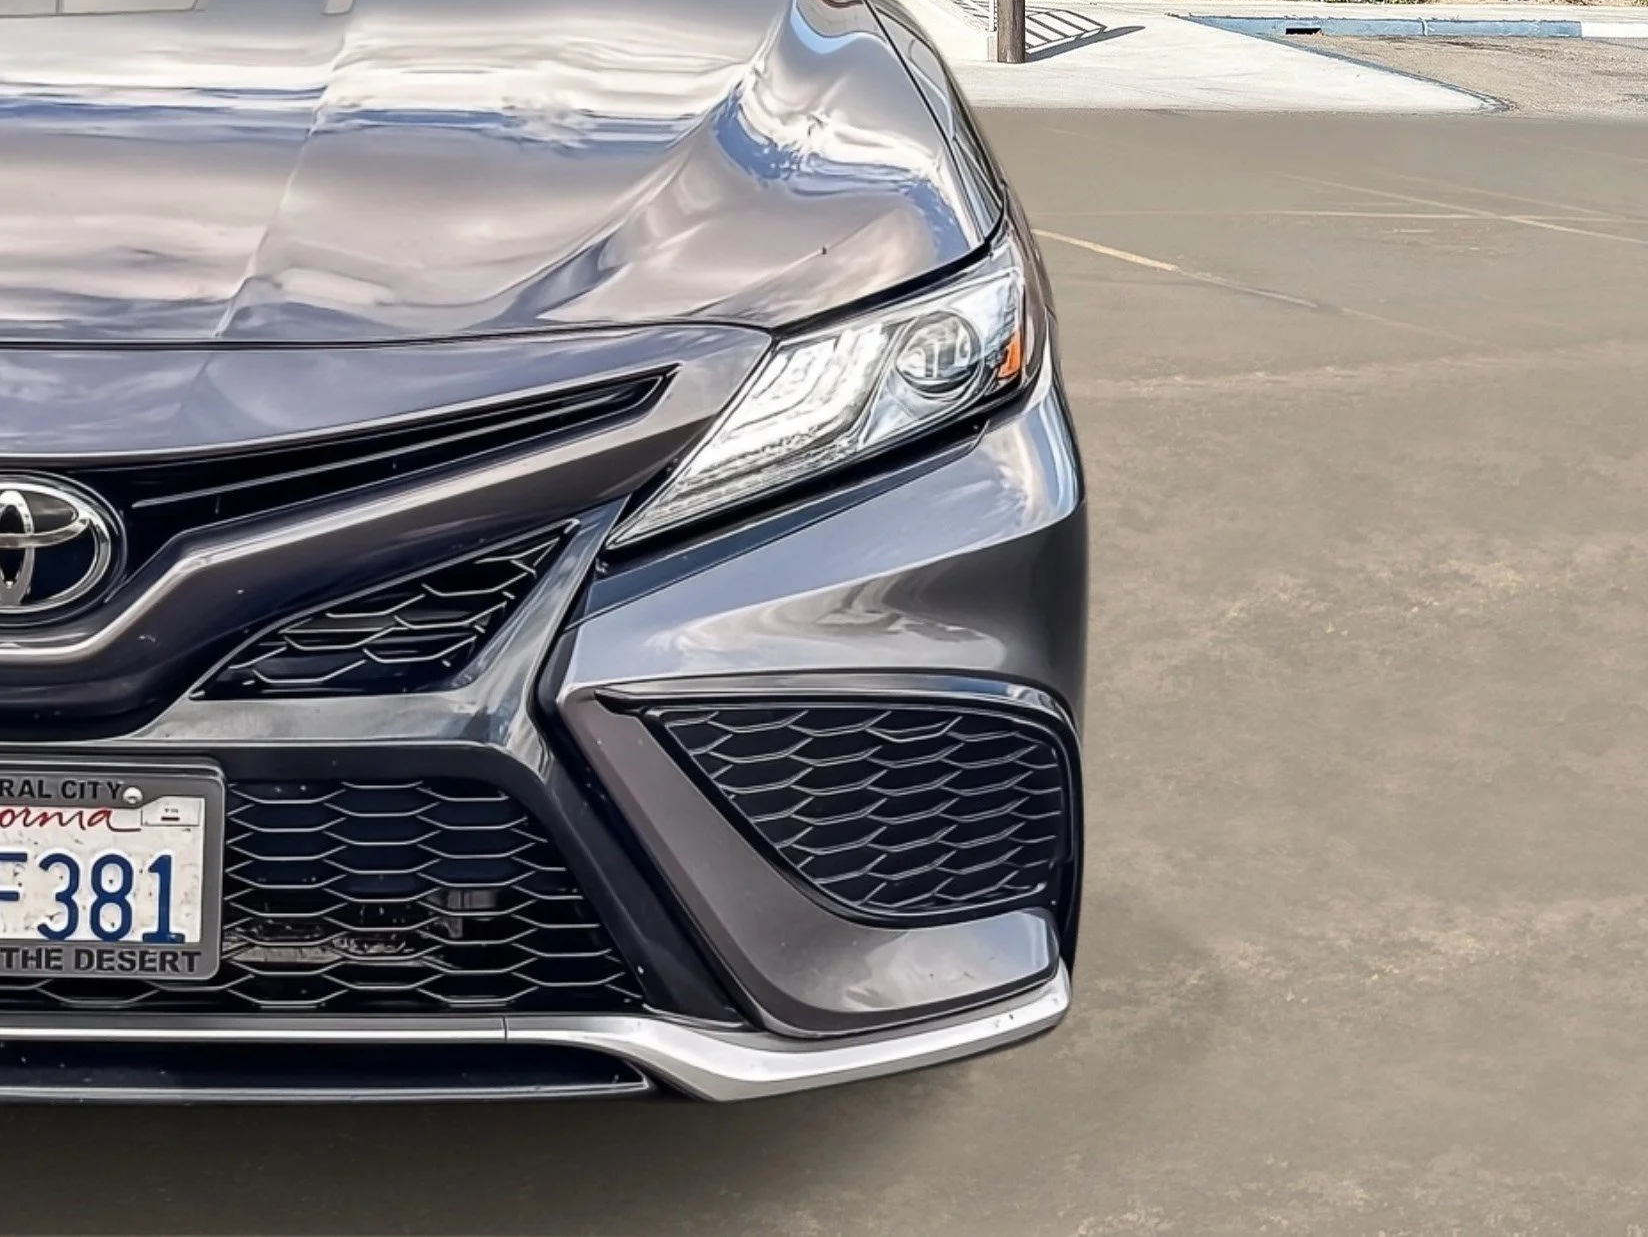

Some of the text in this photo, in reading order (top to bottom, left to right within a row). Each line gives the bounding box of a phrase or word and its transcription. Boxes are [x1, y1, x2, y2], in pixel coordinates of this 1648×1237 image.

[60, 780, 126, 801] CITY
[0, 947, 63, 972] THE
[74, 948, 202, 973] DESERT
